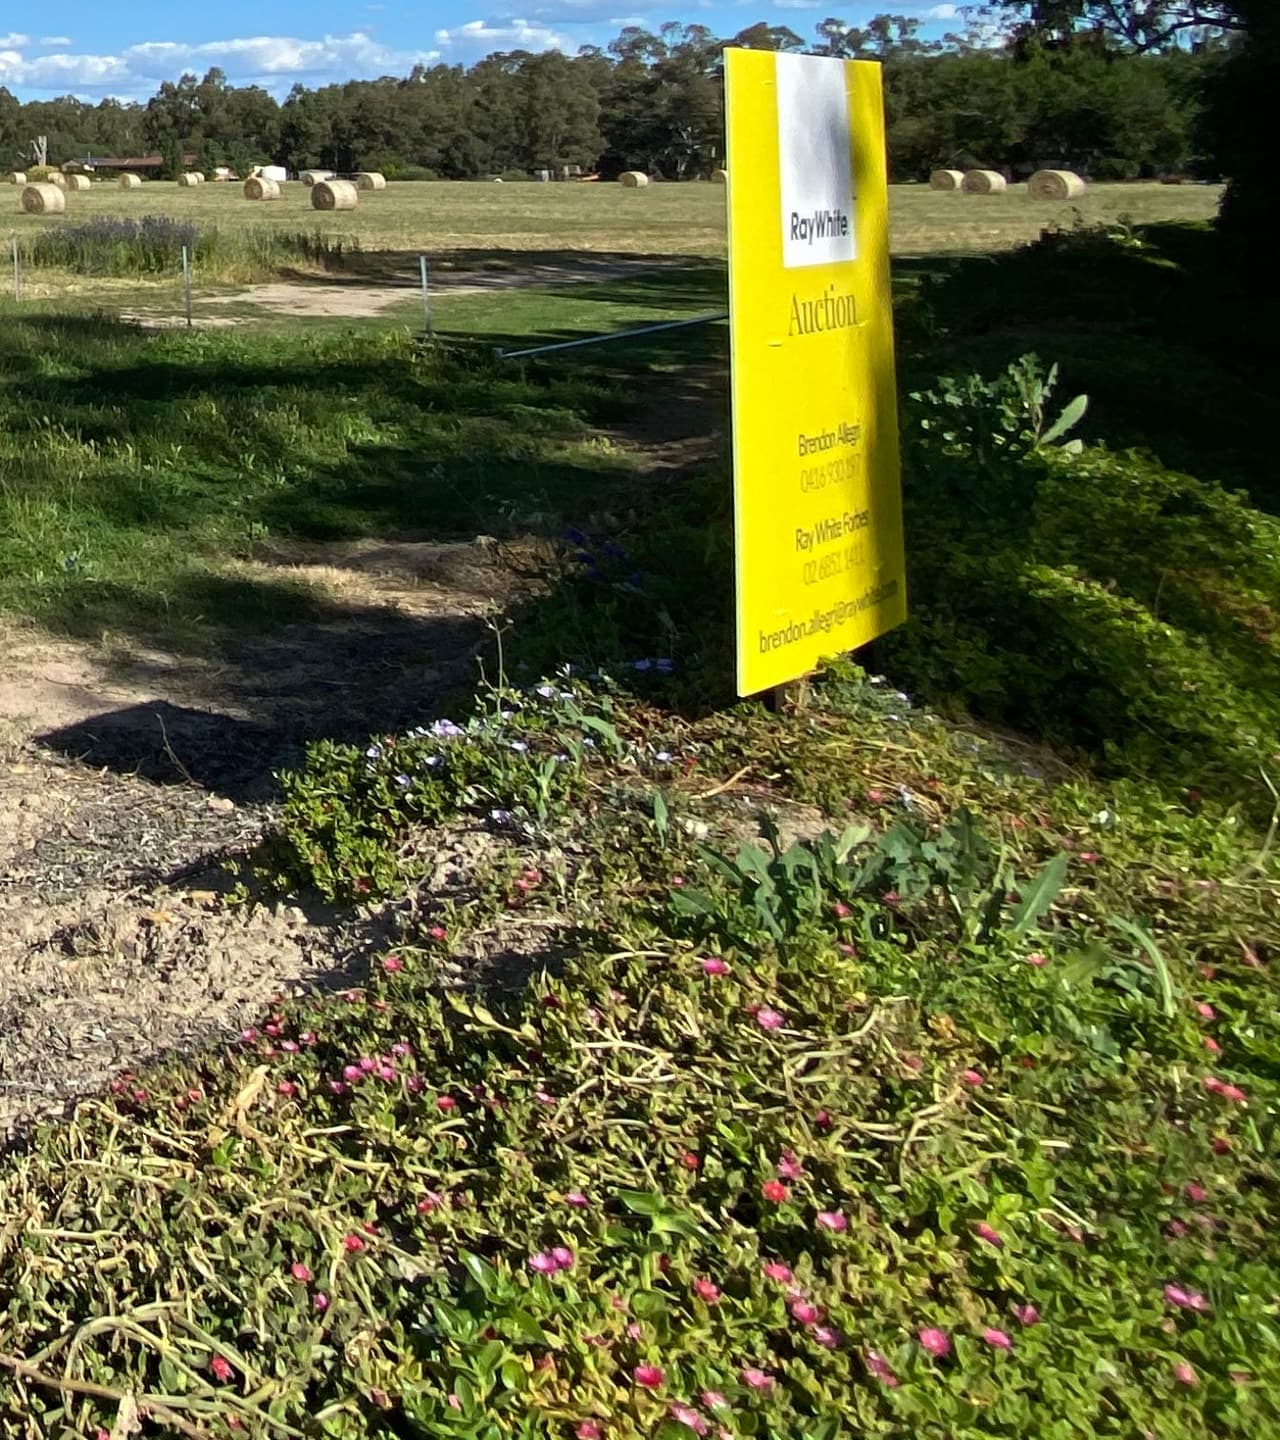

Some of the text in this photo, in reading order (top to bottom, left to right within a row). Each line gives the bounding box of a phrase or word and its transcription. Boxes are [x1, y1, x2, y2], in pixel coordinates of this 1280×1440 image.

[788, 283, 858, 336] Auction
[798, 428, 836, 456] Brendon
[795, 528, 814, 552] Ray
[815, 517, 842, 545] White
[803, 559, 818, 586] 02
